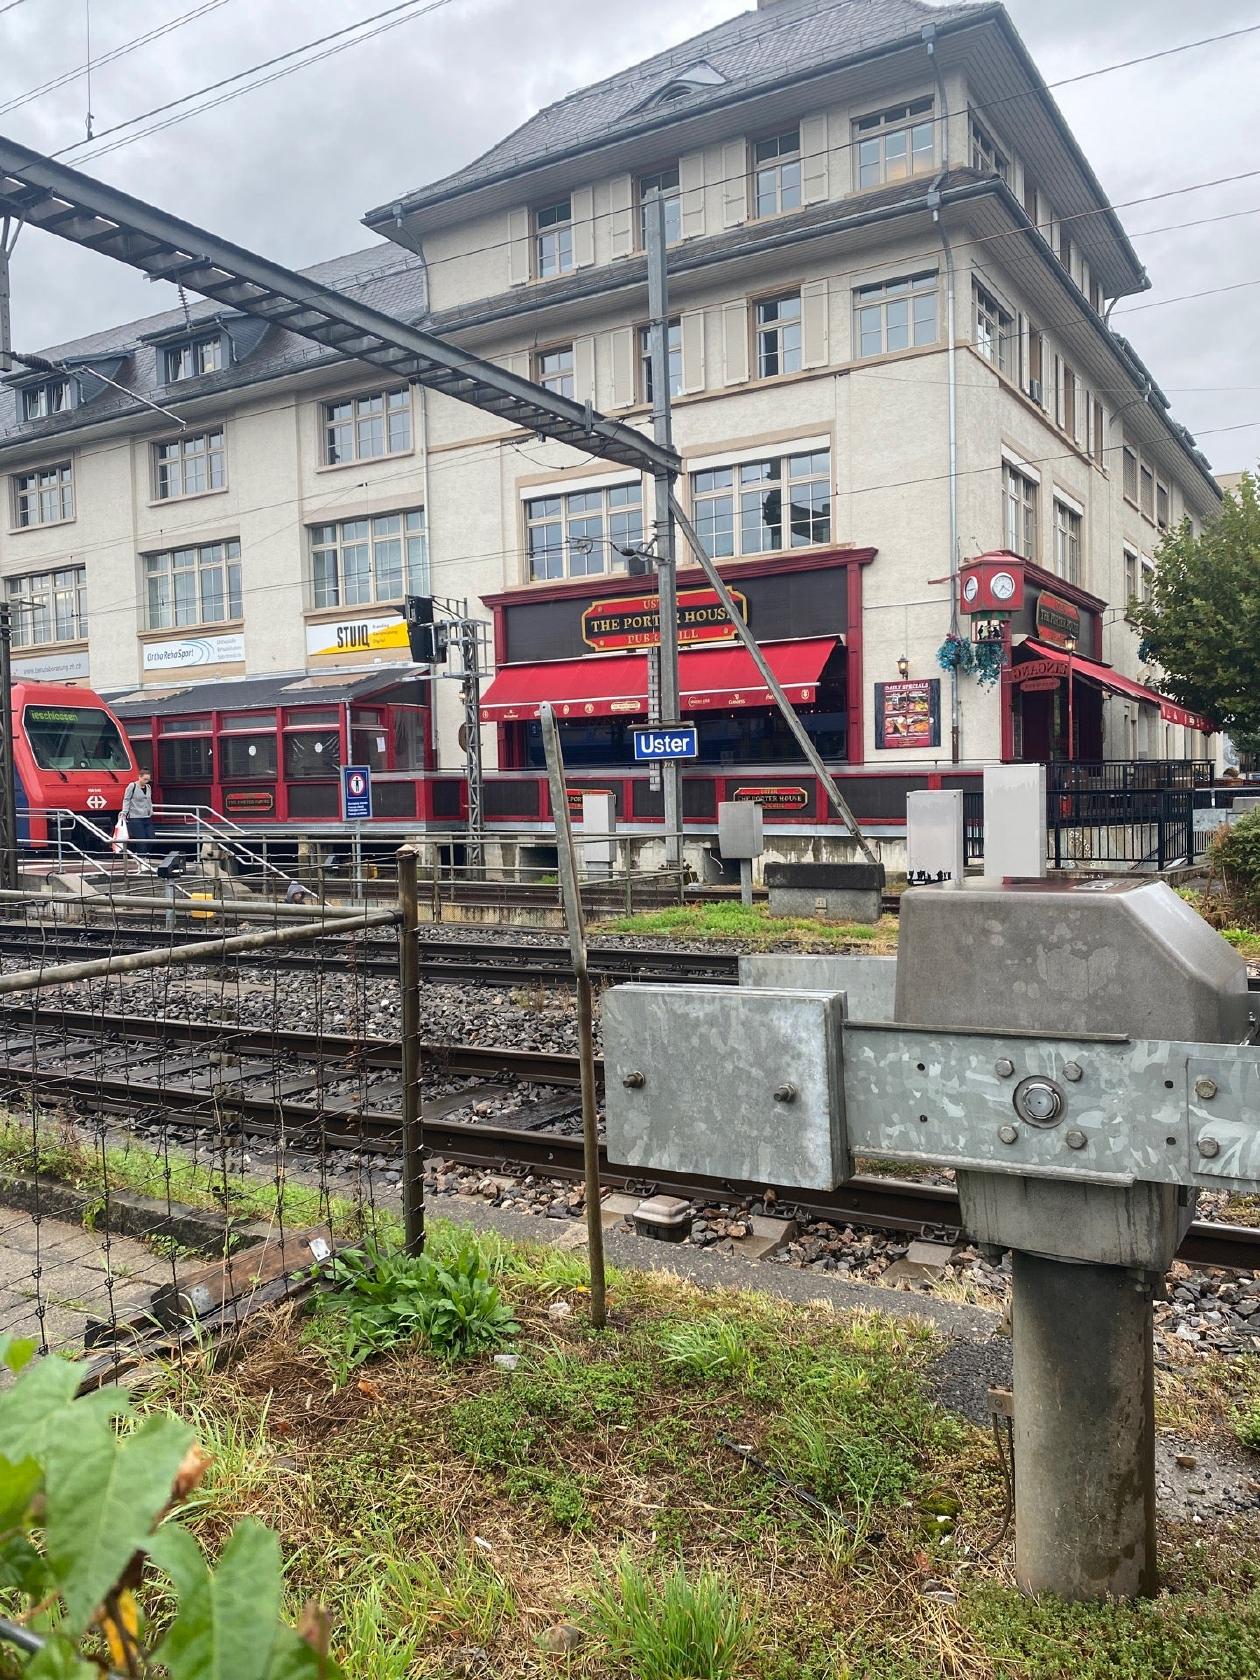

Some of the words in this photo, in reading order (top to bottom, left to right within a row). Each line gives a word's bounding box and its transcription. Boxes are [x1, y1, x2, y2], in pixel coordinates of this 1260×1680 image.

[591, 619, 619, 632] THE
[623, 612, 680, 629] PORTR
[685, 607, 730, 622] HOUS
[337, 624, 370, 648] STUIQ
[628, 633, 650, 644] PUB
[641, 734, 690, 754] Uster
